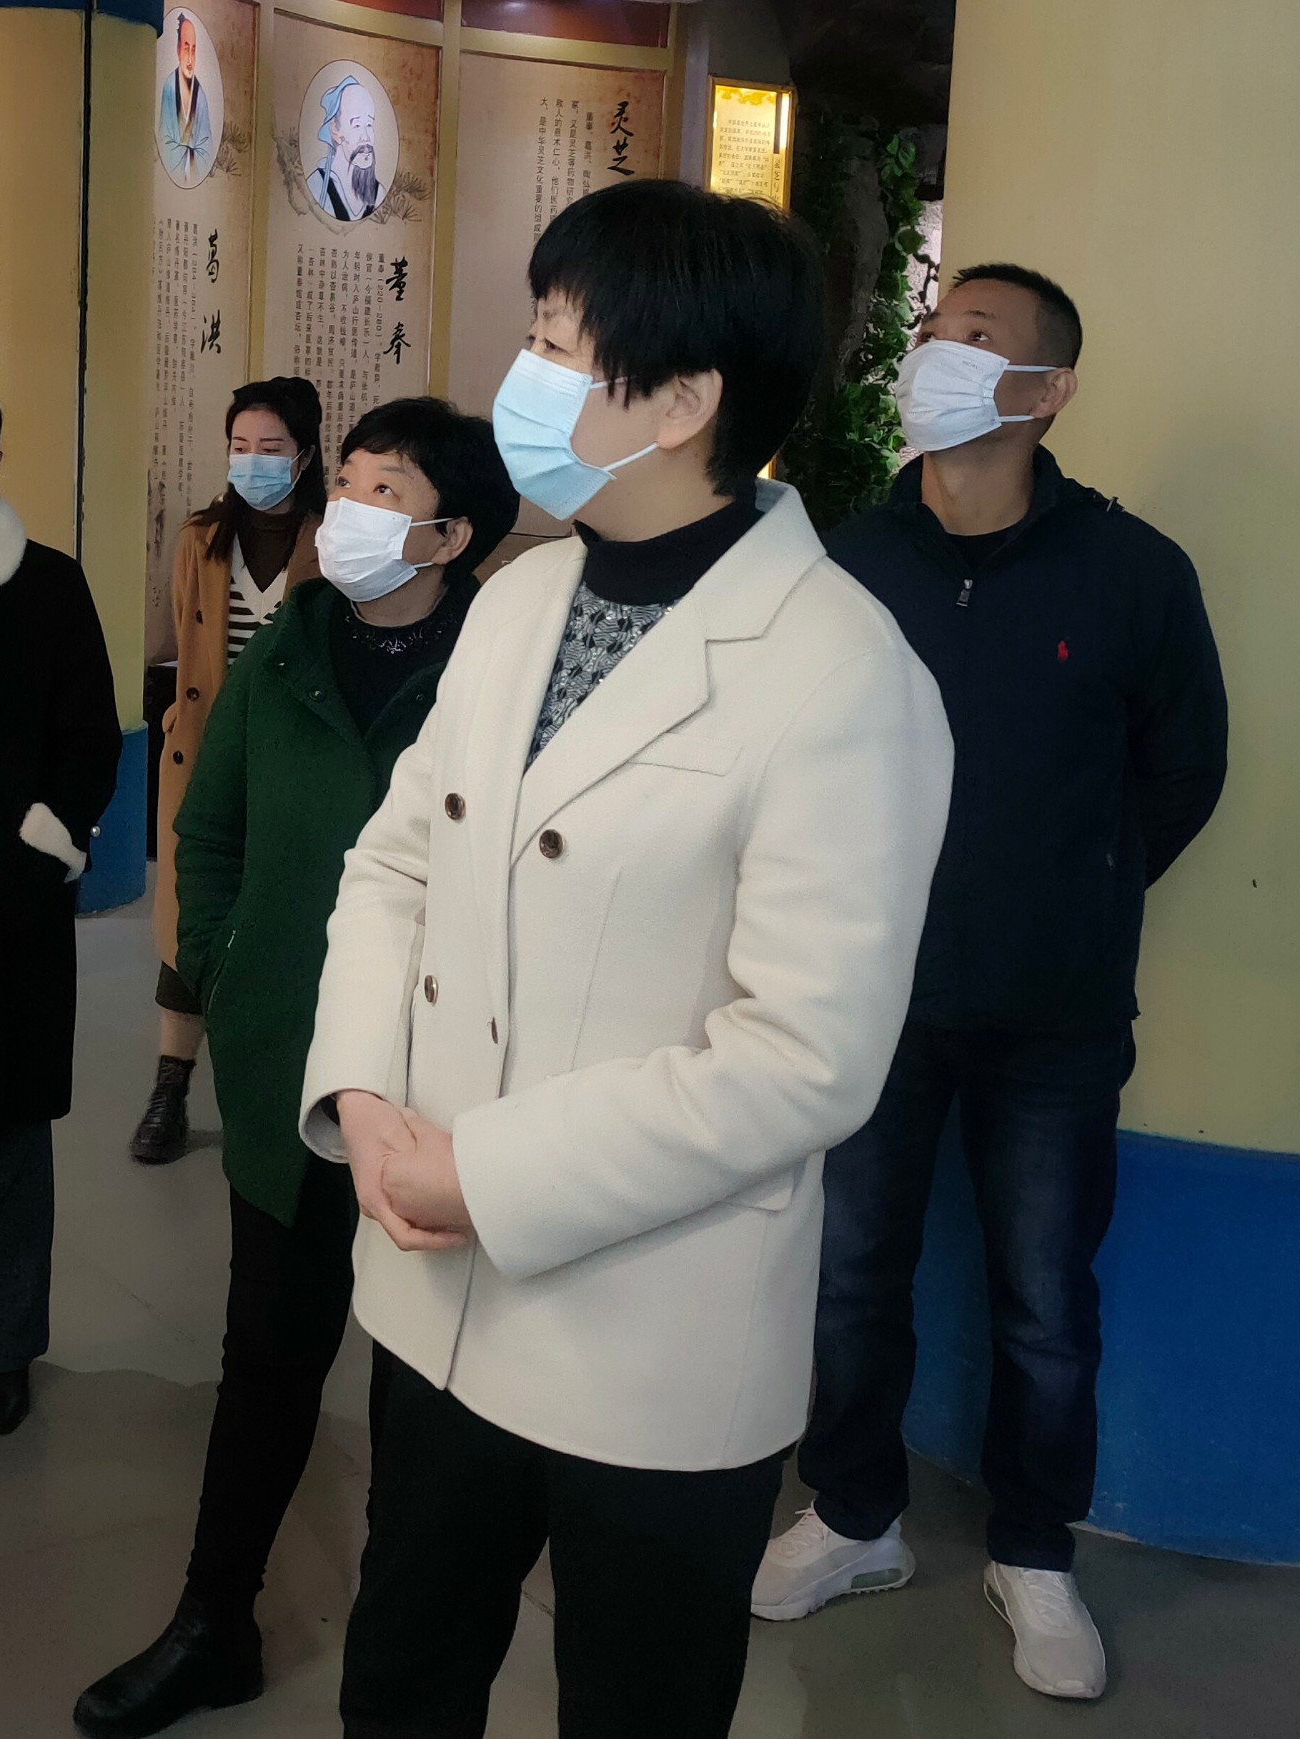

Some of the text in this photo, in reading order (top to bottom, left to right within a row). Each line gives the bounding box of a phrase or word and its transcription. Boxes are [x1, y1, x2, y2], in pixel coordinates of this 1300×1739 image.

[607, 101, 635, 176] 灵芝
[201, 228, 222, 354] 葛洪
[383, 256, 411, 364] 董奉
